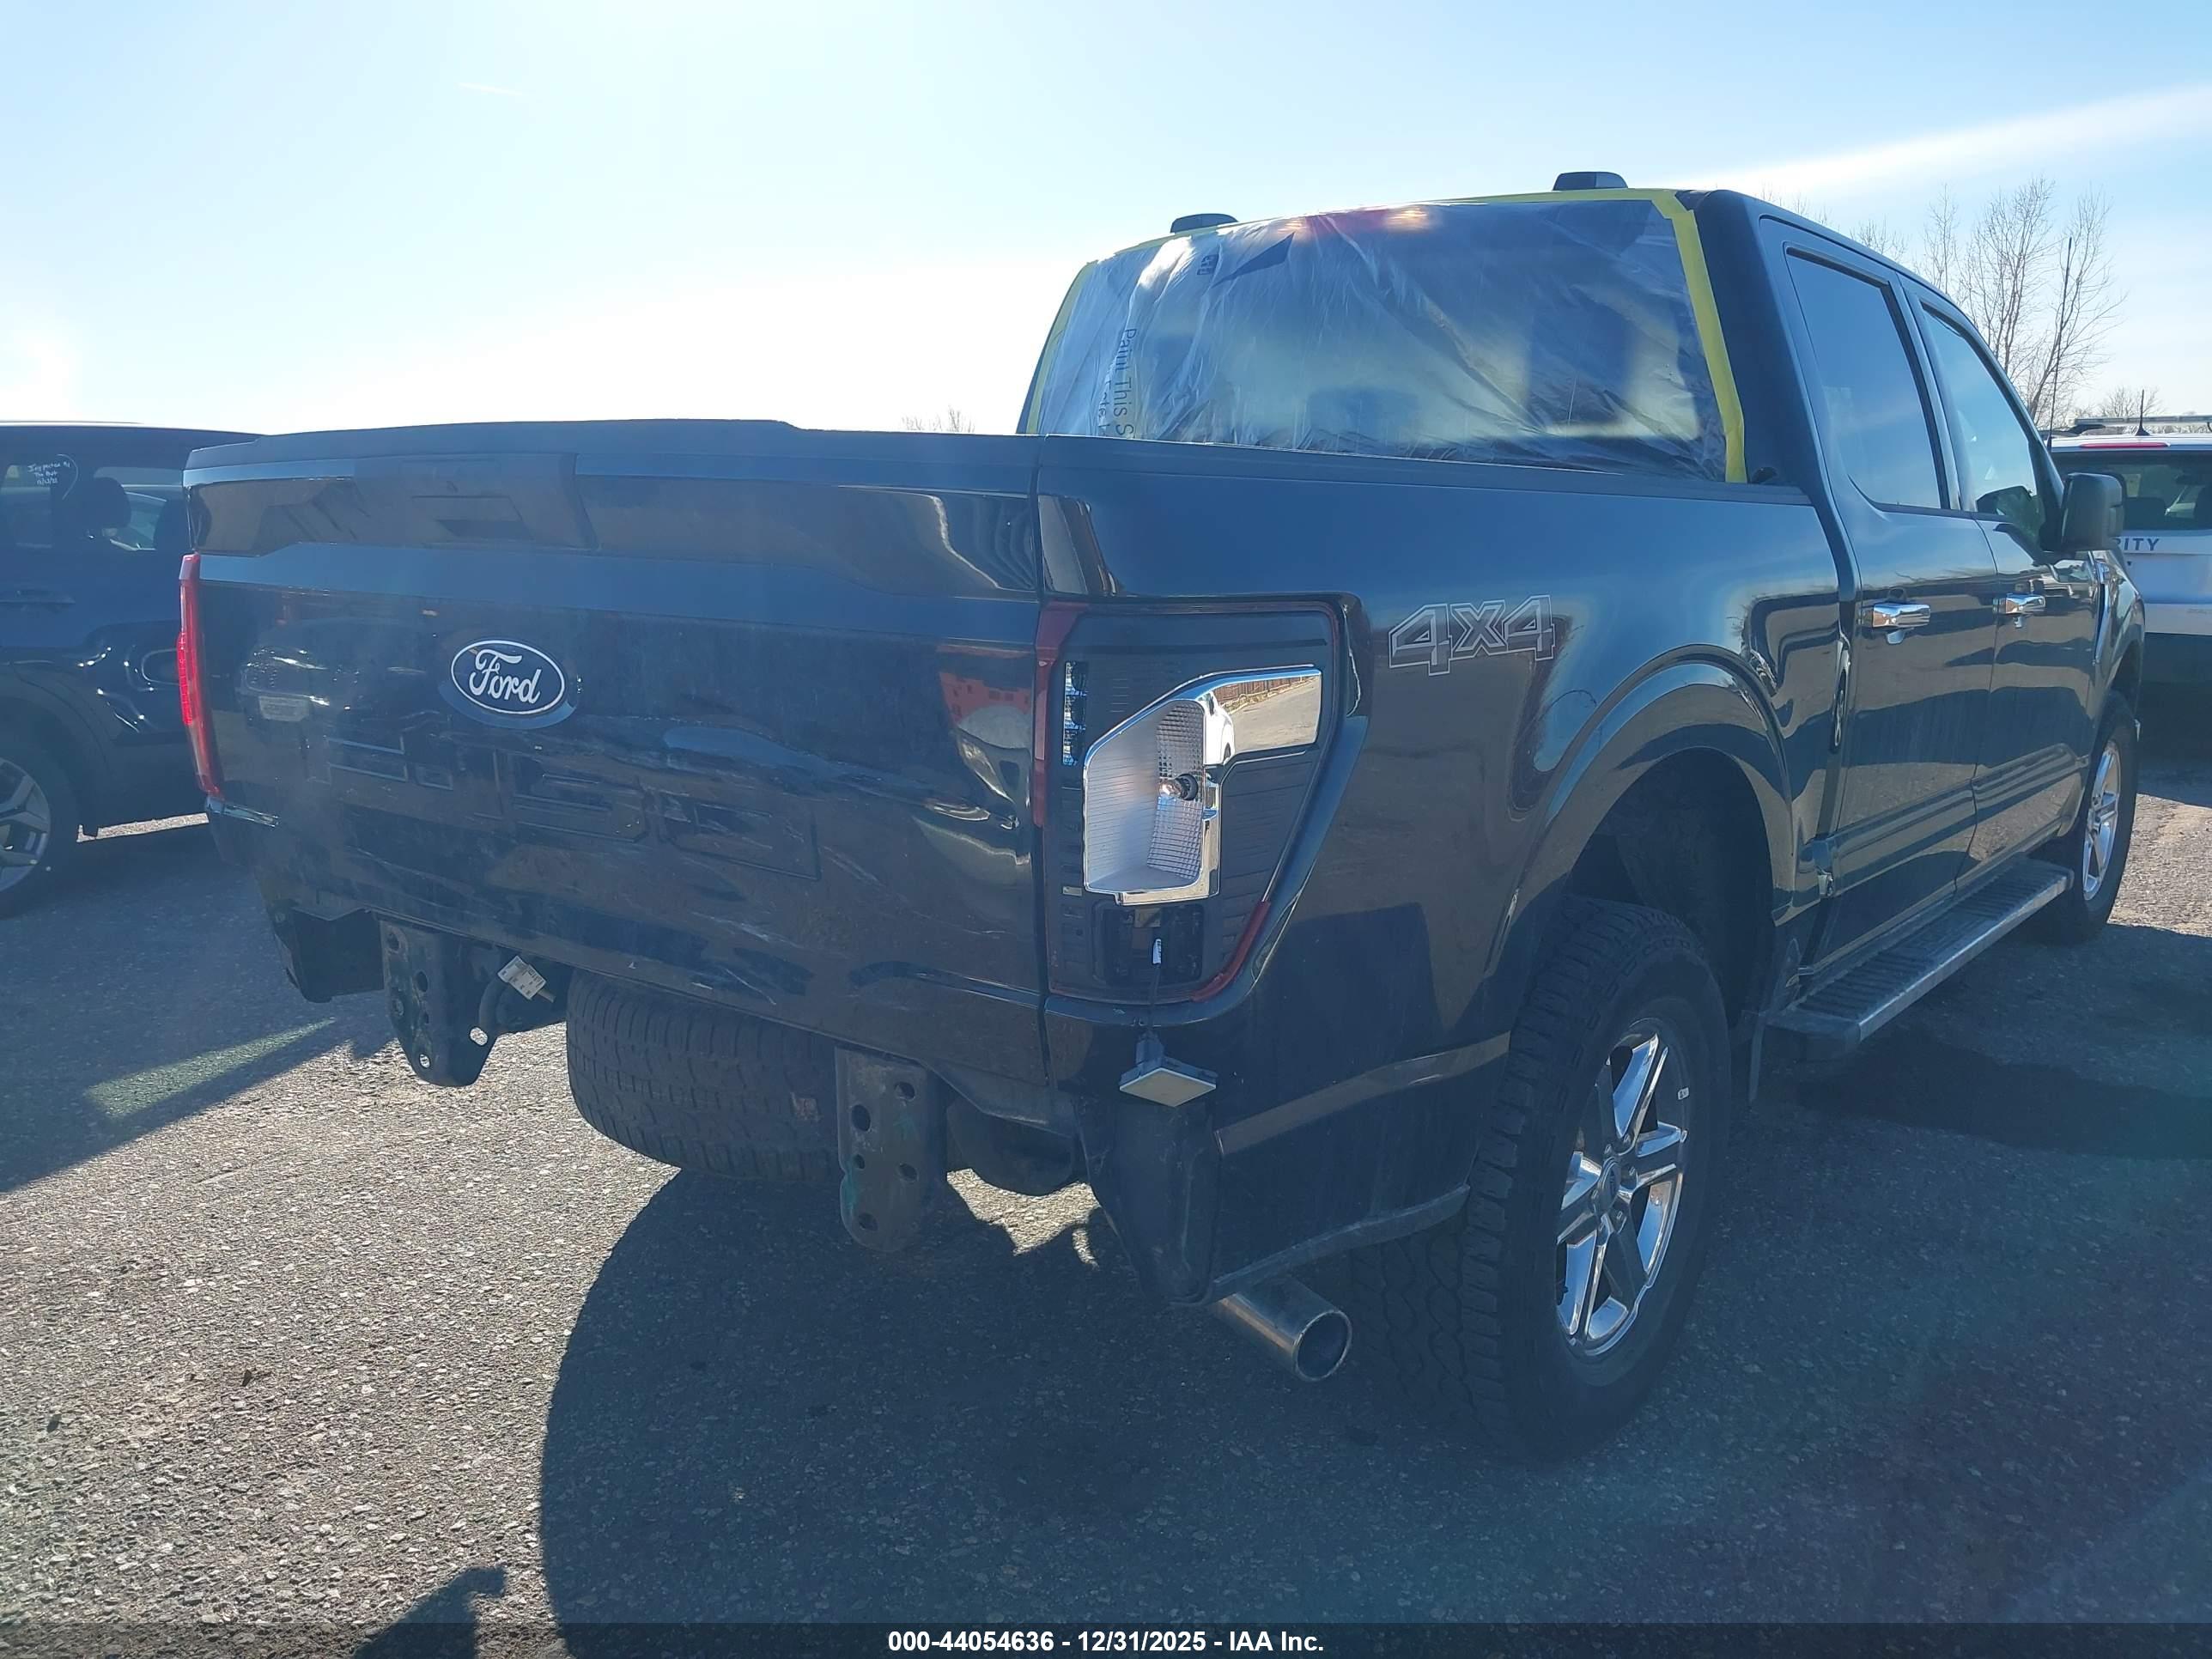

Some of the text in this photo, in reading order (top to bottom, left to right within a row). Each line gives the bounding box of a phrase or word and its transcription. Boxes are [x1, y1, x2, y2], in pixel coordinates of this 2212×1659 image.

[1114, 377, 1133, 418] This
[1115, 423, 1135, 438] S
[469, 648, 542, 704] Ford
